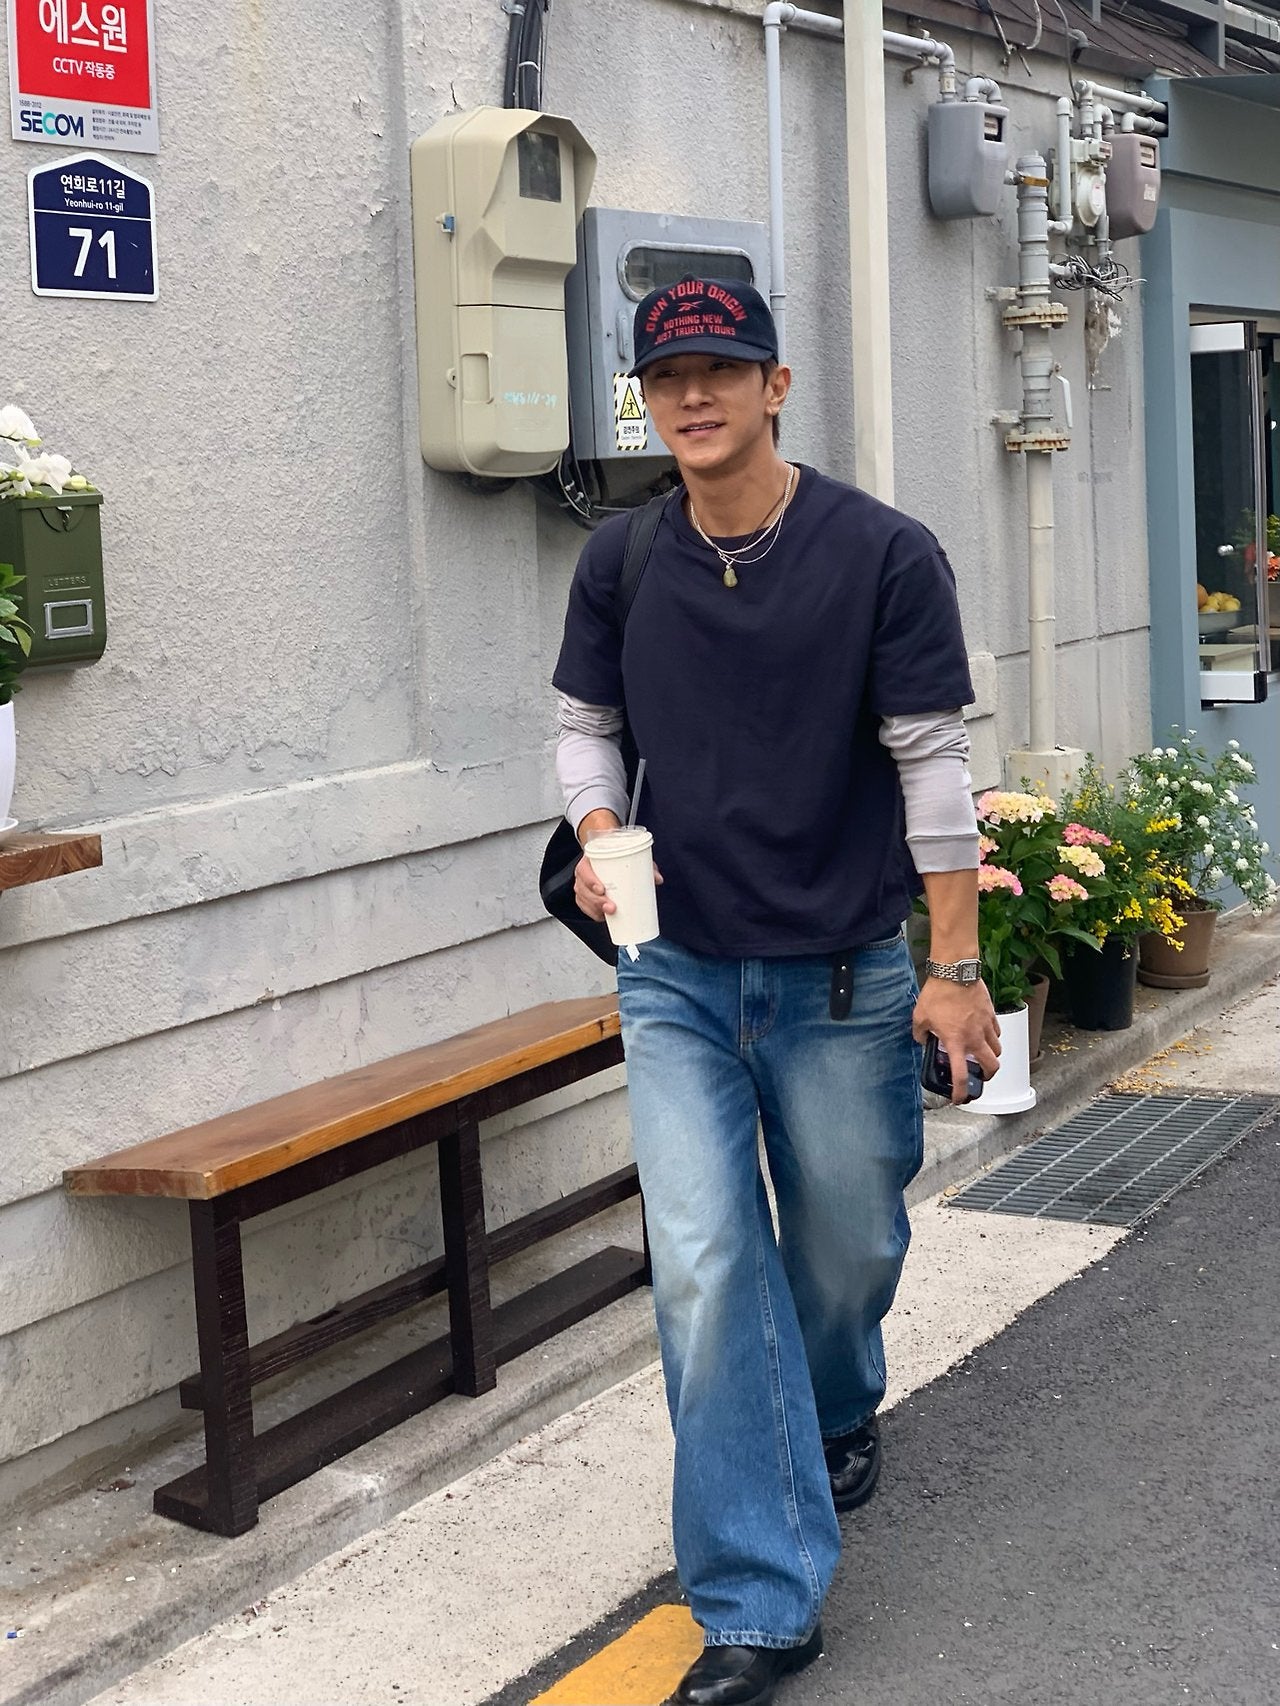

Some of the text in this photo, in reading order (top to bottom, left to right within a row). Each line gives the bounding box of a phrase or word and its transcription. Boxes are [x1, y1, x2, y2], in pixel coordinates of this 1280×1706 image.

[38, 0, 128, 53] 에스원
[20, 110, 84, 138] SECOM
[61, 174, 126, 199] 연희로11길
[64, 197, 124, 213] Yeonhui-ro 11-gil
[68, 227, 117, 279] 71
[646, 280, 748, 333] OWN YOUR ORIGIN
[663, 313, 723, 330] NOTHING NEW
[654, 325, 736, 345] JUST TRUELY YOURS
